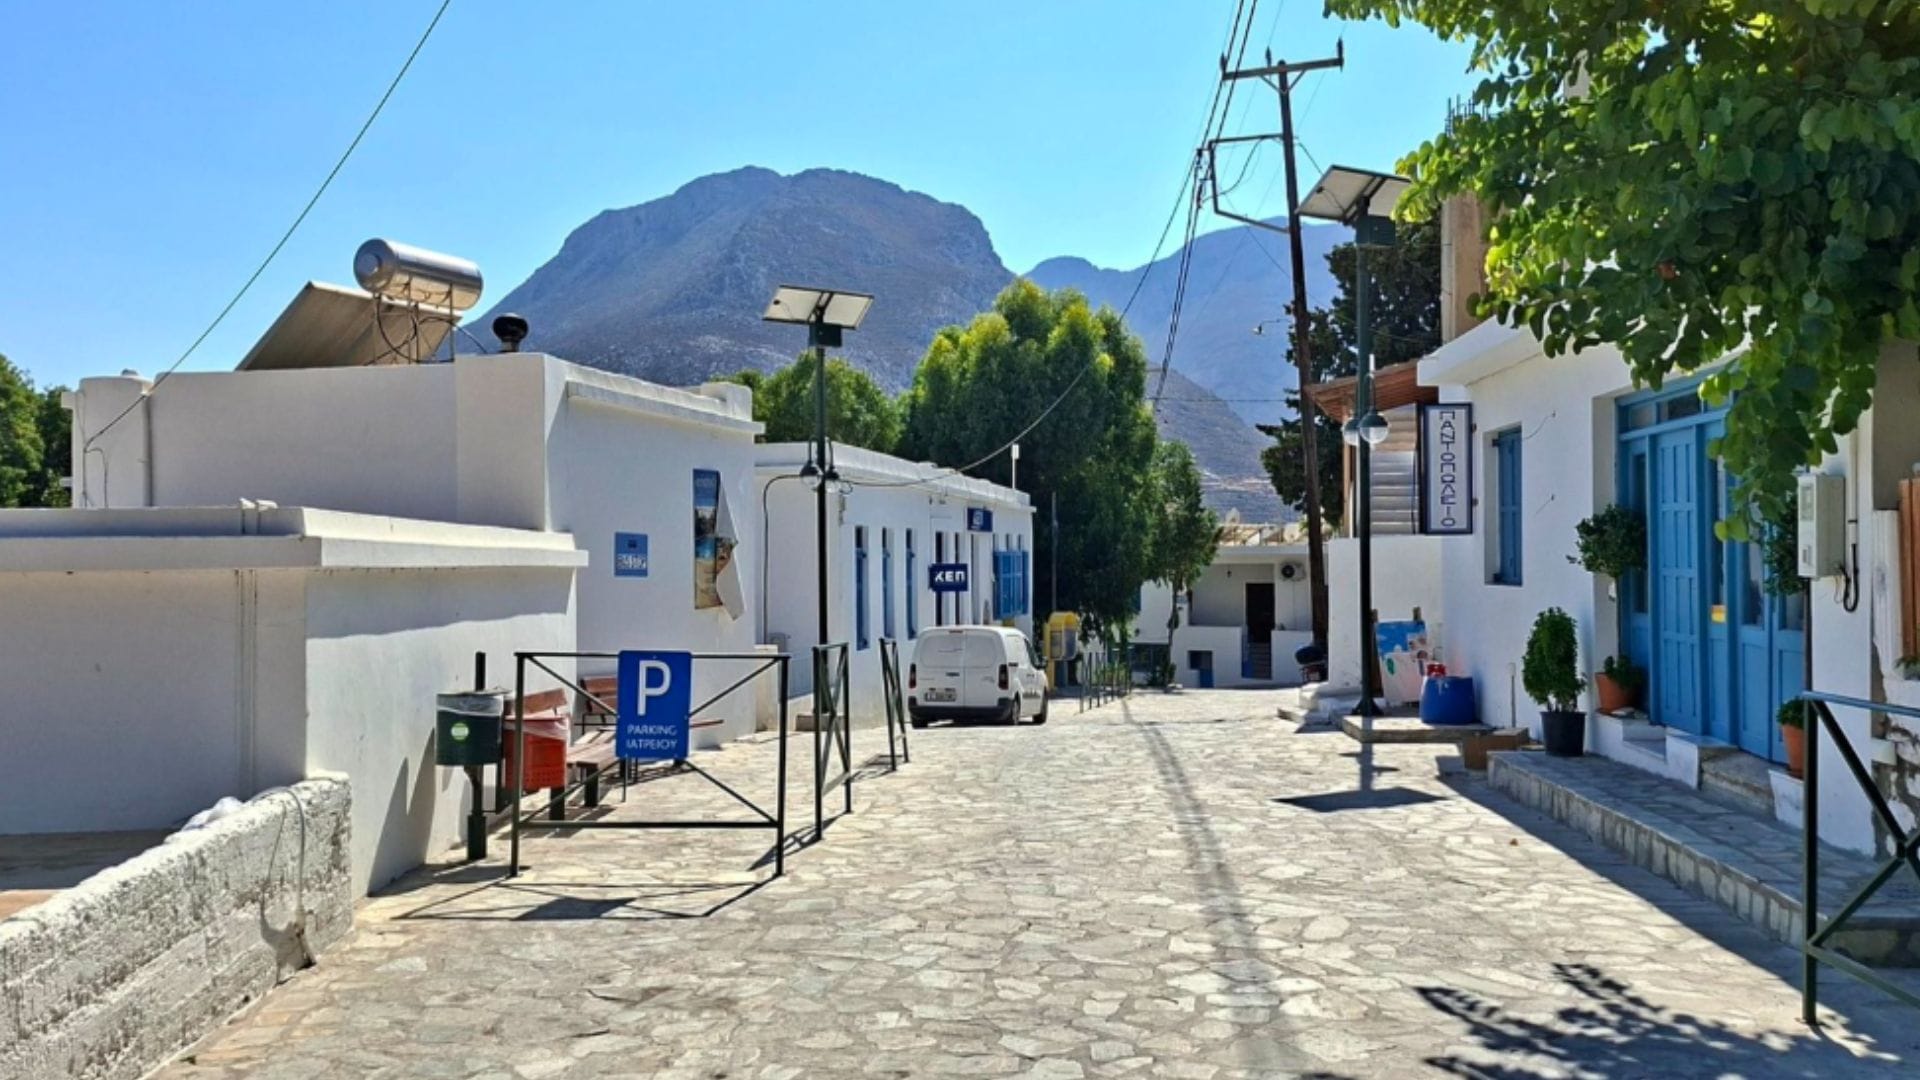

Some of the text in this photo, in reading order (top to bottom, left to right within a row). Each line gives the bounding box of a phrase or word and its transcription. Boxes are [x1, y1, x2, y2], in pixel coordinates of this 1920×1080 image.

[1440, 411, 1456, 527] ΠΑΝΤΟΠΩΛΕΙΟ
[935, 571, 966, 582] ΚΕΠ
[637, 660, 672, 716] P
[626, 724, 678, 736] PARKING
[625, 738, 678, 750] ΙΑΤΡΕΙΟΥ
